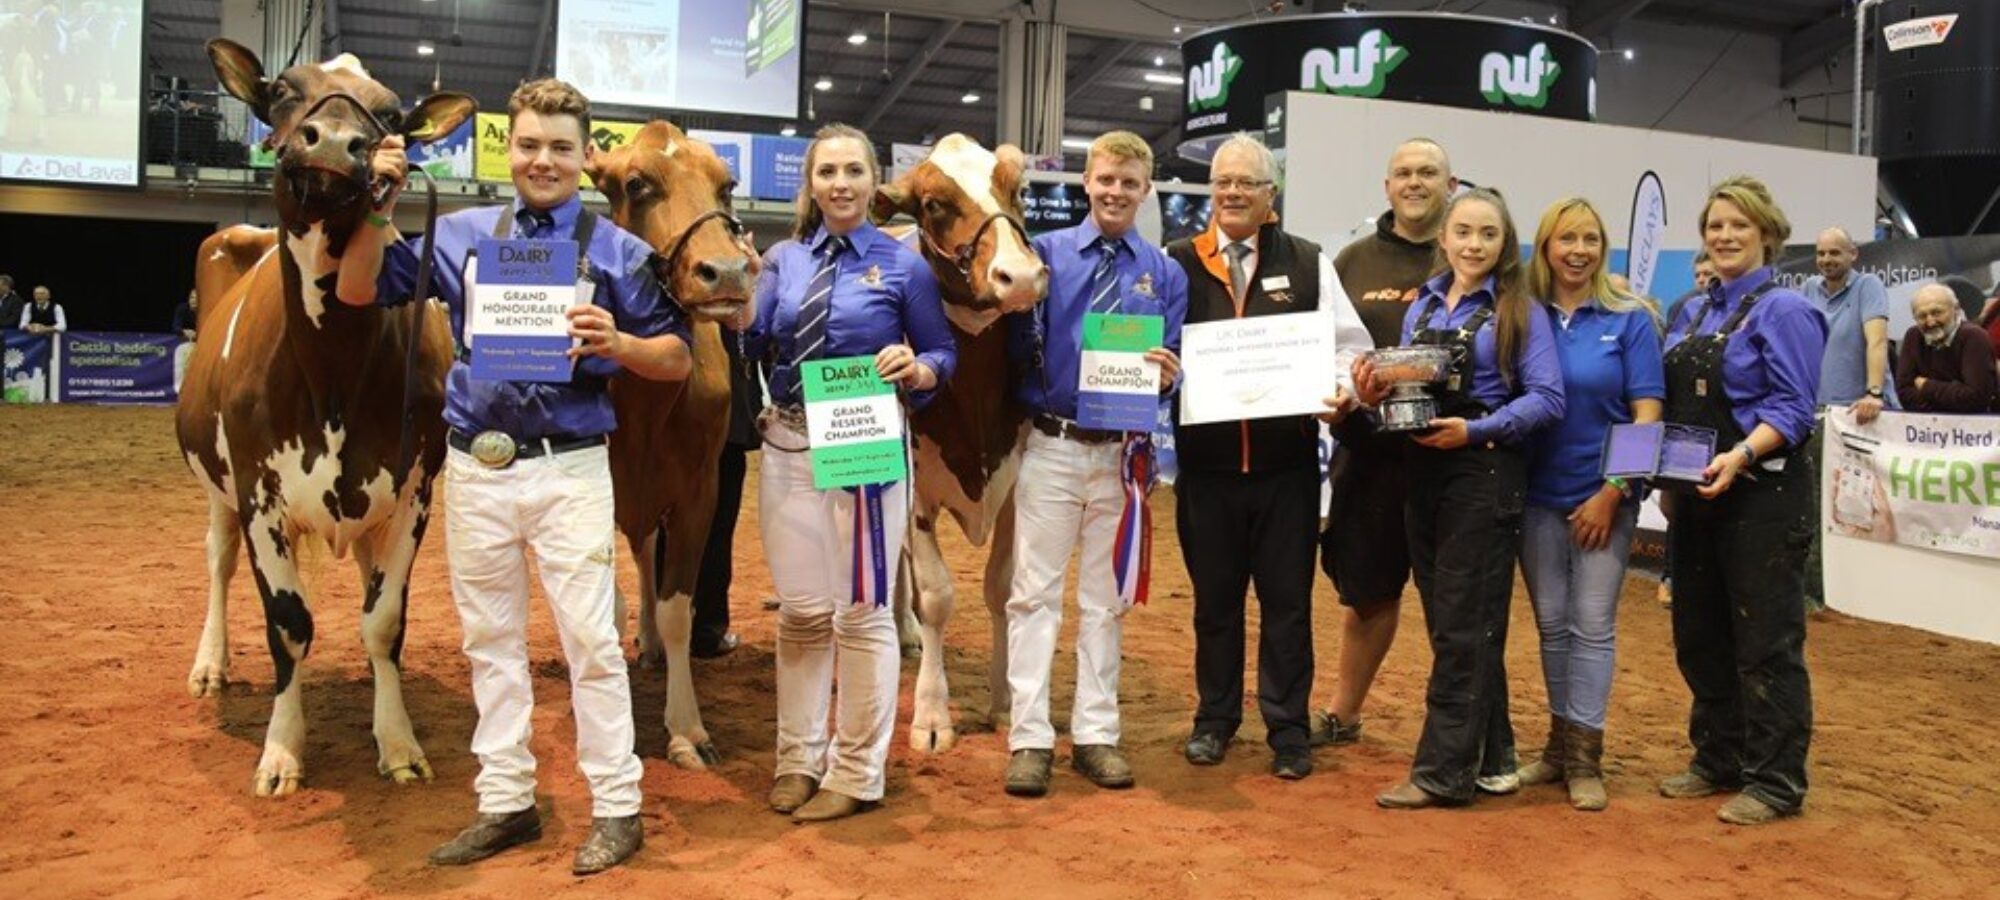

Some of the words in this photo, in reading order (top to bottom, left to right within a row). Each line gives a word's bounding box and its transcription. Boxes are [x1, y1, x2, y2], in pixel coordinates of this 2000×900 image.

[45, 159, 132, 180] DeLaval
[1634, 192, 1660, 290] ARCLAYS
[499, 246, 553, 263] DAIRY
[503, 291, 547, 301] GRAND
[483, 303, 567, 314] HONOURABLE
[495, 316, 553, 326] MENTION
[69, 341, 111, 353] Cattle
[114, 342, 166, 357] bedding
[69, 356, 141, 367] specialists
[822, 365, 871, 382] DAIRY
[1099, 365, 1142, 376] GRAND
[1086, 375, 1153, 388] CHAMPION
[833, 405, 872, 417] GRAND
[831, 416, 876, 428] RESERVE
[824, 427, 886, 440] CHAMPION
[1906, 425, 1948, 448] Dairy
[1952, 428, 1992, 447] Herd
[1889, 456, 2000, 508] HERE
[1972, 516, 2000, 530] Mana
